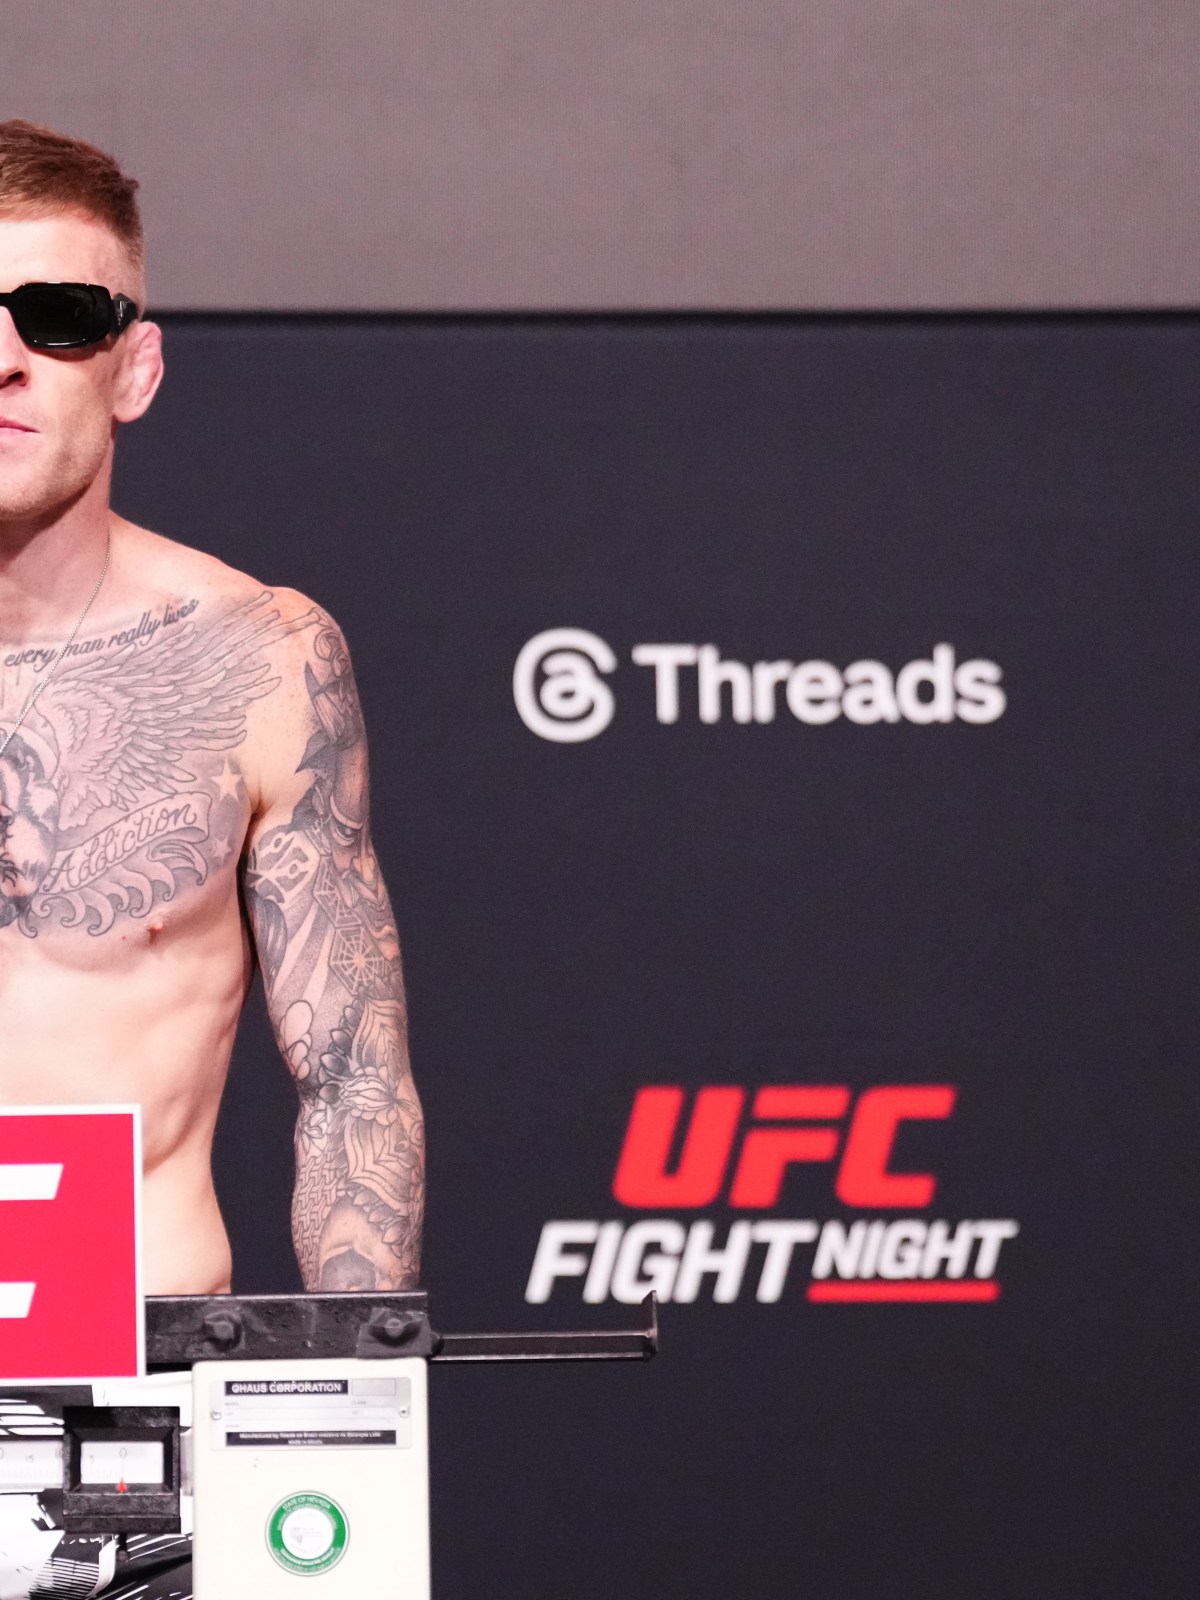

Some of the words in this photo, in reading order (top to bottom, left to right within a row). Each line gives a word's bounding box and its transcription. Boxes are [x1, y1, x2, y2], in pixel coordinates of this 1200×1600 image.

[4, 648, 57, 673] every
[63, 638, 104, 658] man
[106, 609, 160, 648] really
[162, 598, 200, 628] lives
[631, 643, 1006, 725] Threads
[43, 803, 197, 892] Addiction
[612, 1085, 957, 1209] UFC
[524, 1220, 818, 1303] FIGHT
[812, 1219, 1019, 1279] NIGHT
[269, 1381, 342, 1393] CORPORATION
[119, 1447, 128, 1459] 0
